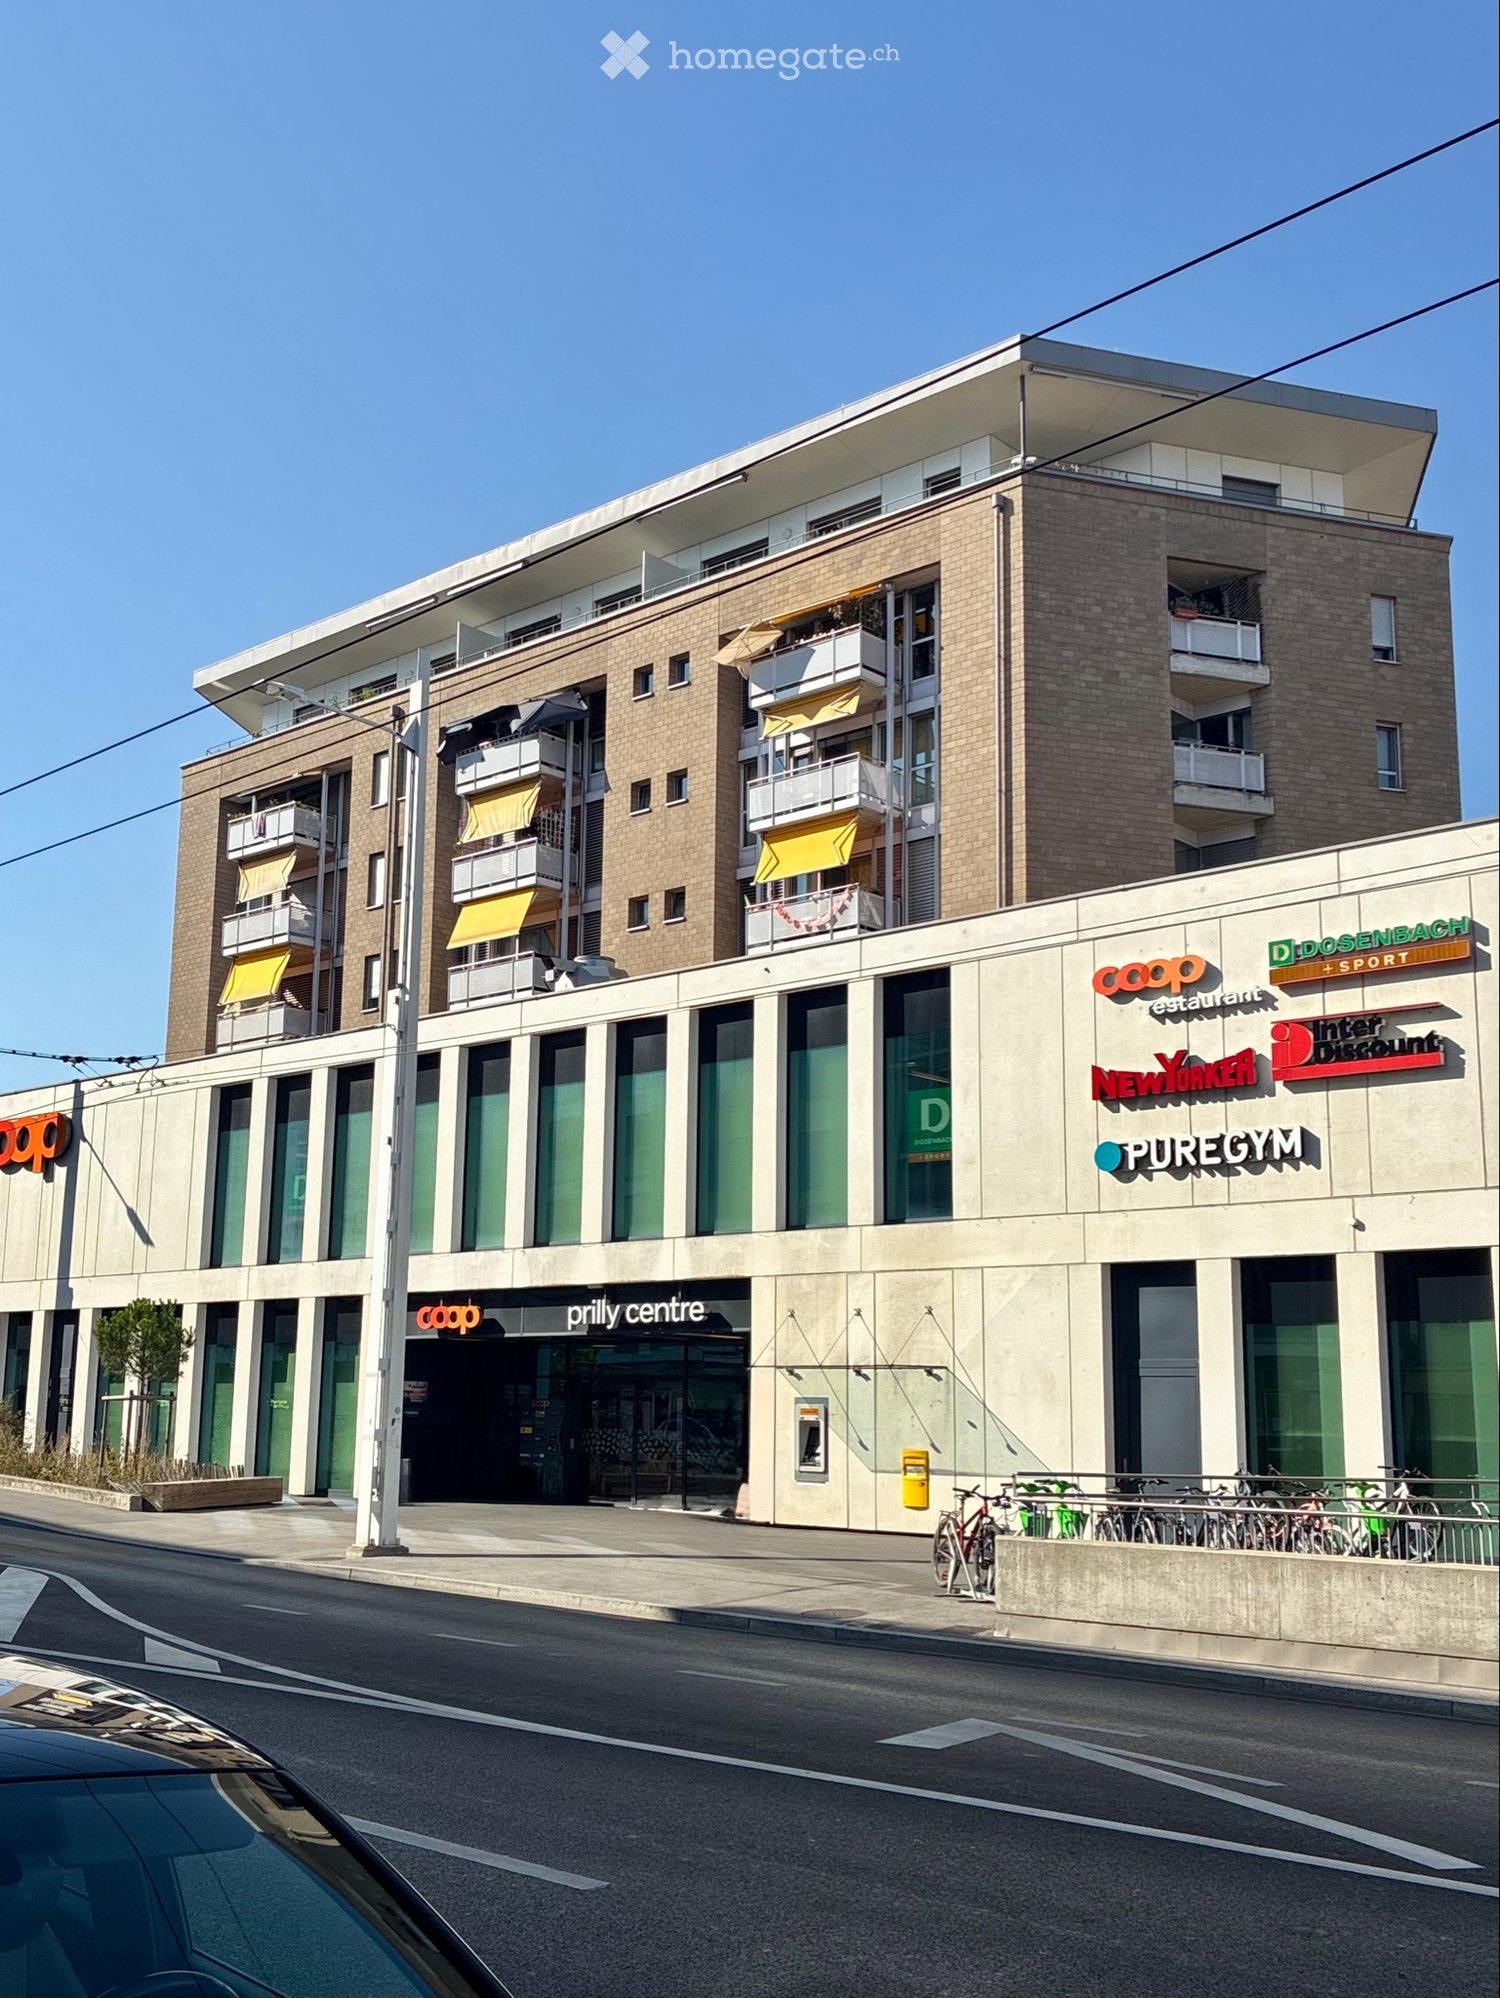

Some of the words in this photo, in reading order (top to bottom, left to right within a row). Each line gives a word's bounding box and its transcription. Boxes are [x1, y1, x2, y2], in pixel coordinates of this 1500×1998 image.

[1299, 916, 1470, 958] DOSENBACH
[1092, 953, 1206, 997] coop
[1338, 952, 1410, 973] SPORT
[1313, 1013, 1383, 1041] Inter
[1313, 1030, 1445, 1063] Discount
[920, 1097, 951, 1133] D
[1122, 1125, 1303, 1171] PUREGYM
[416, 1304, 481, 1334] coop
[566, 1298, 621, 1331] prilly
[625, 1296, 705, 1325] centre
